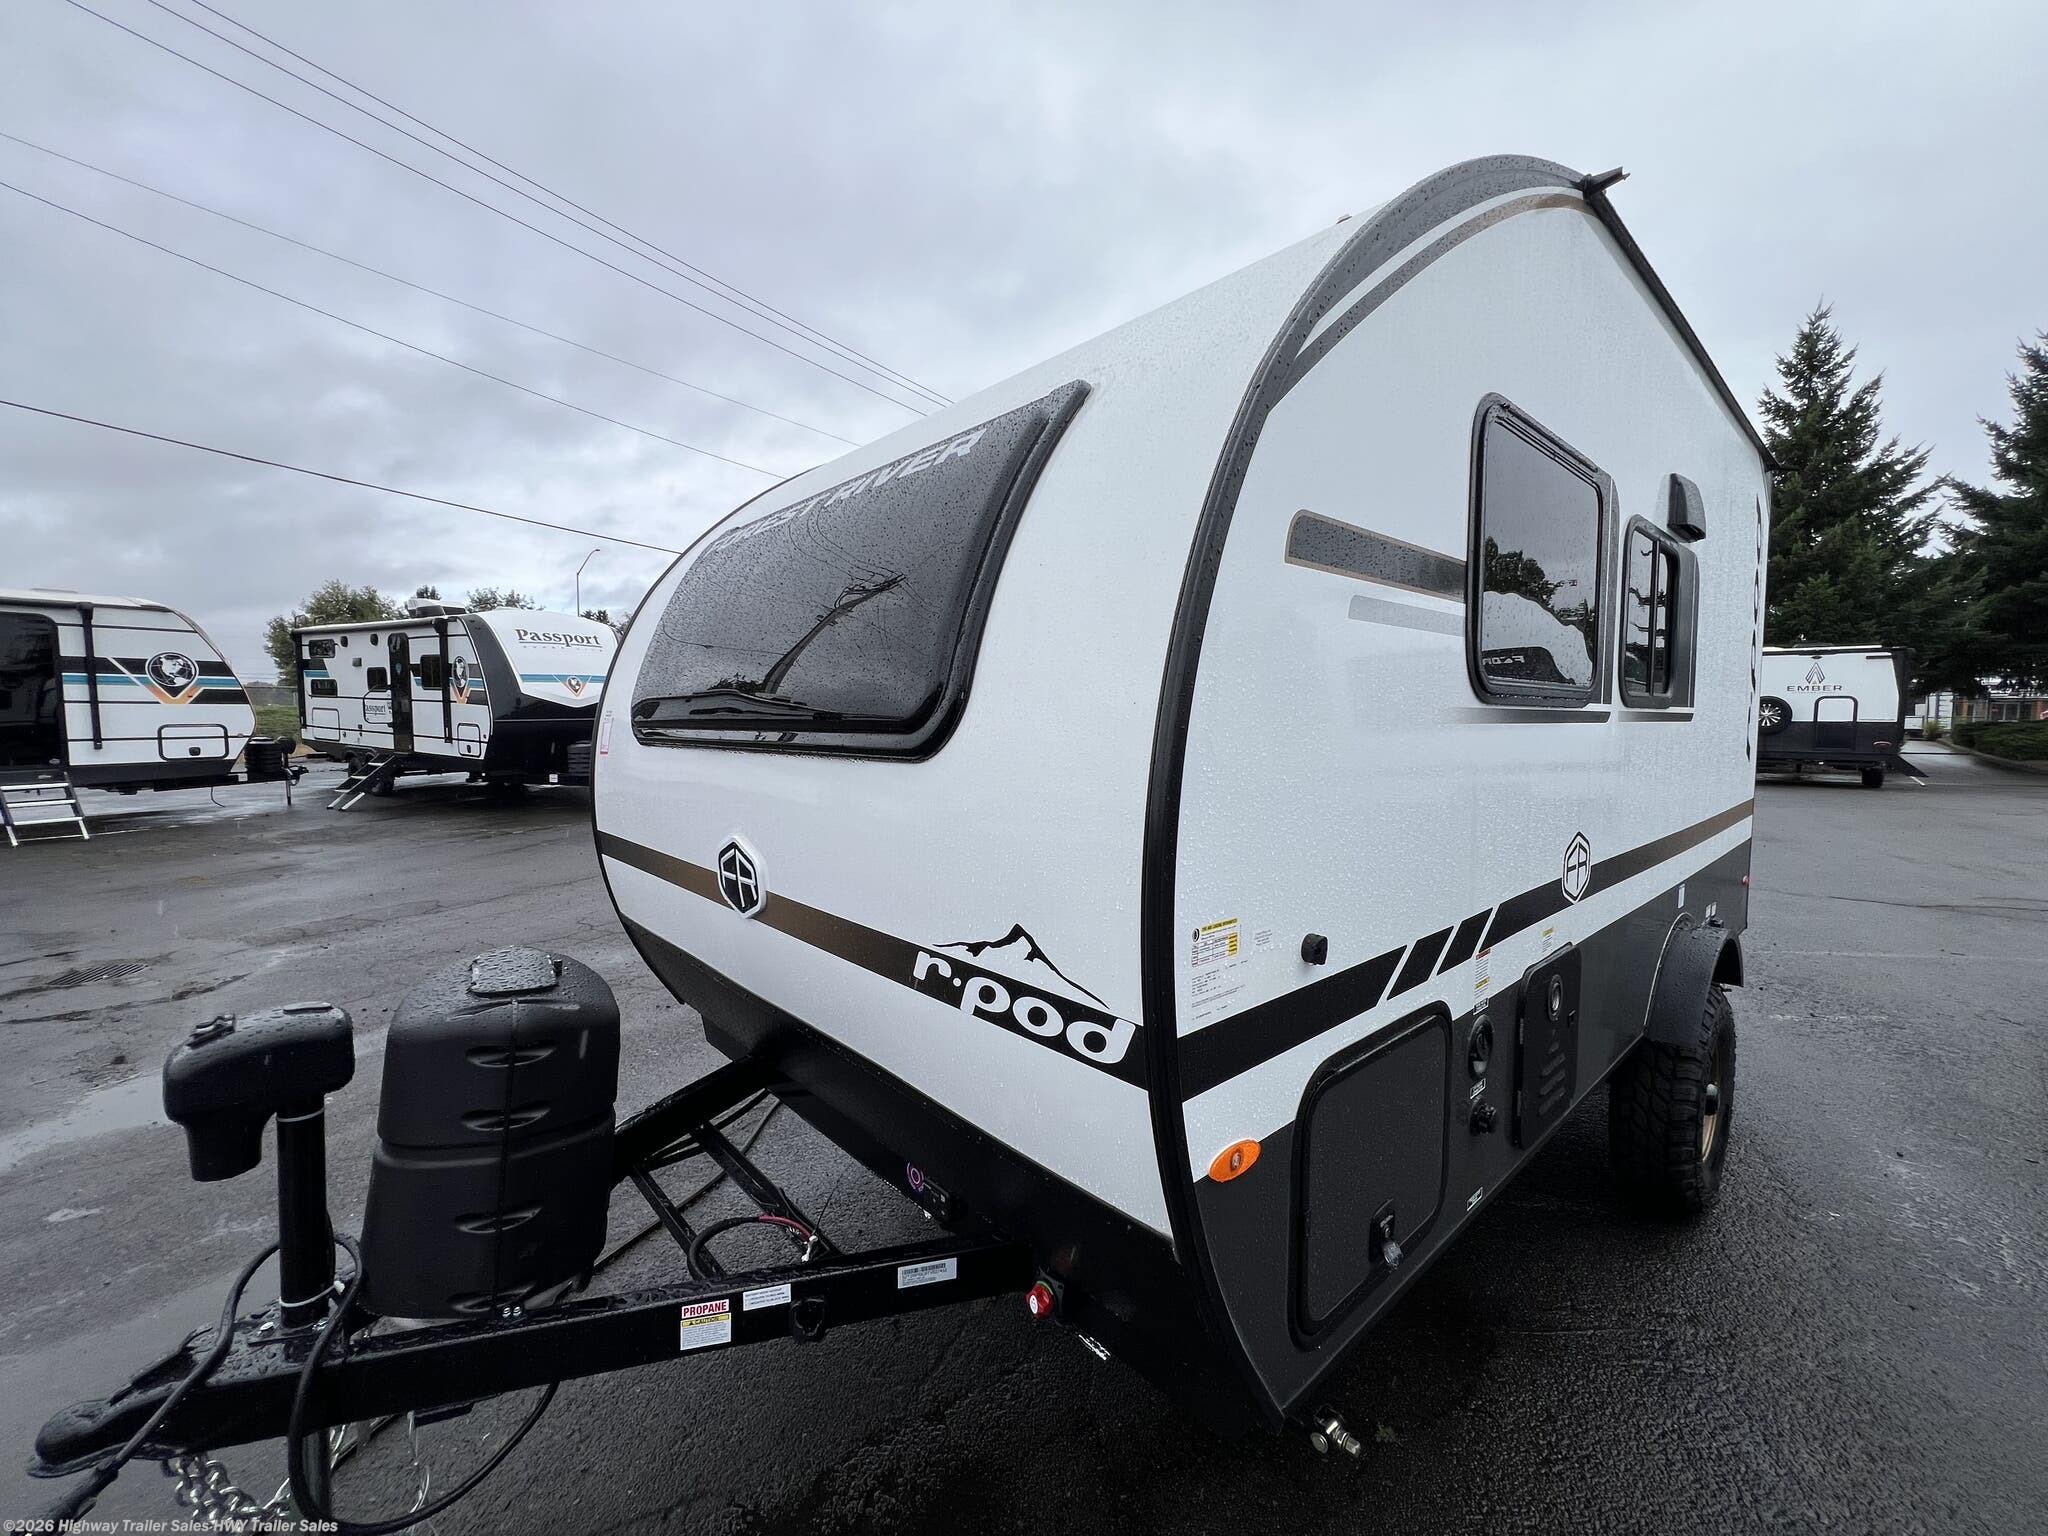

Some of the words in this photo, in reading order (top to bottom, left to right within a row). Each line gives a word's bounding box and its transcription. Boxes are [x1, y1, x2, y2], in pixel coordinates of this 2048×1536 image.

[823, 429, 987, 508] RIVER
[515, 628, 601, 648] Passport
[1786, 684, 1843, 692] EMBER
[683, 1301, 727, 1317] PROPANE
[694, 1316, 720, 1325] CAUTION
